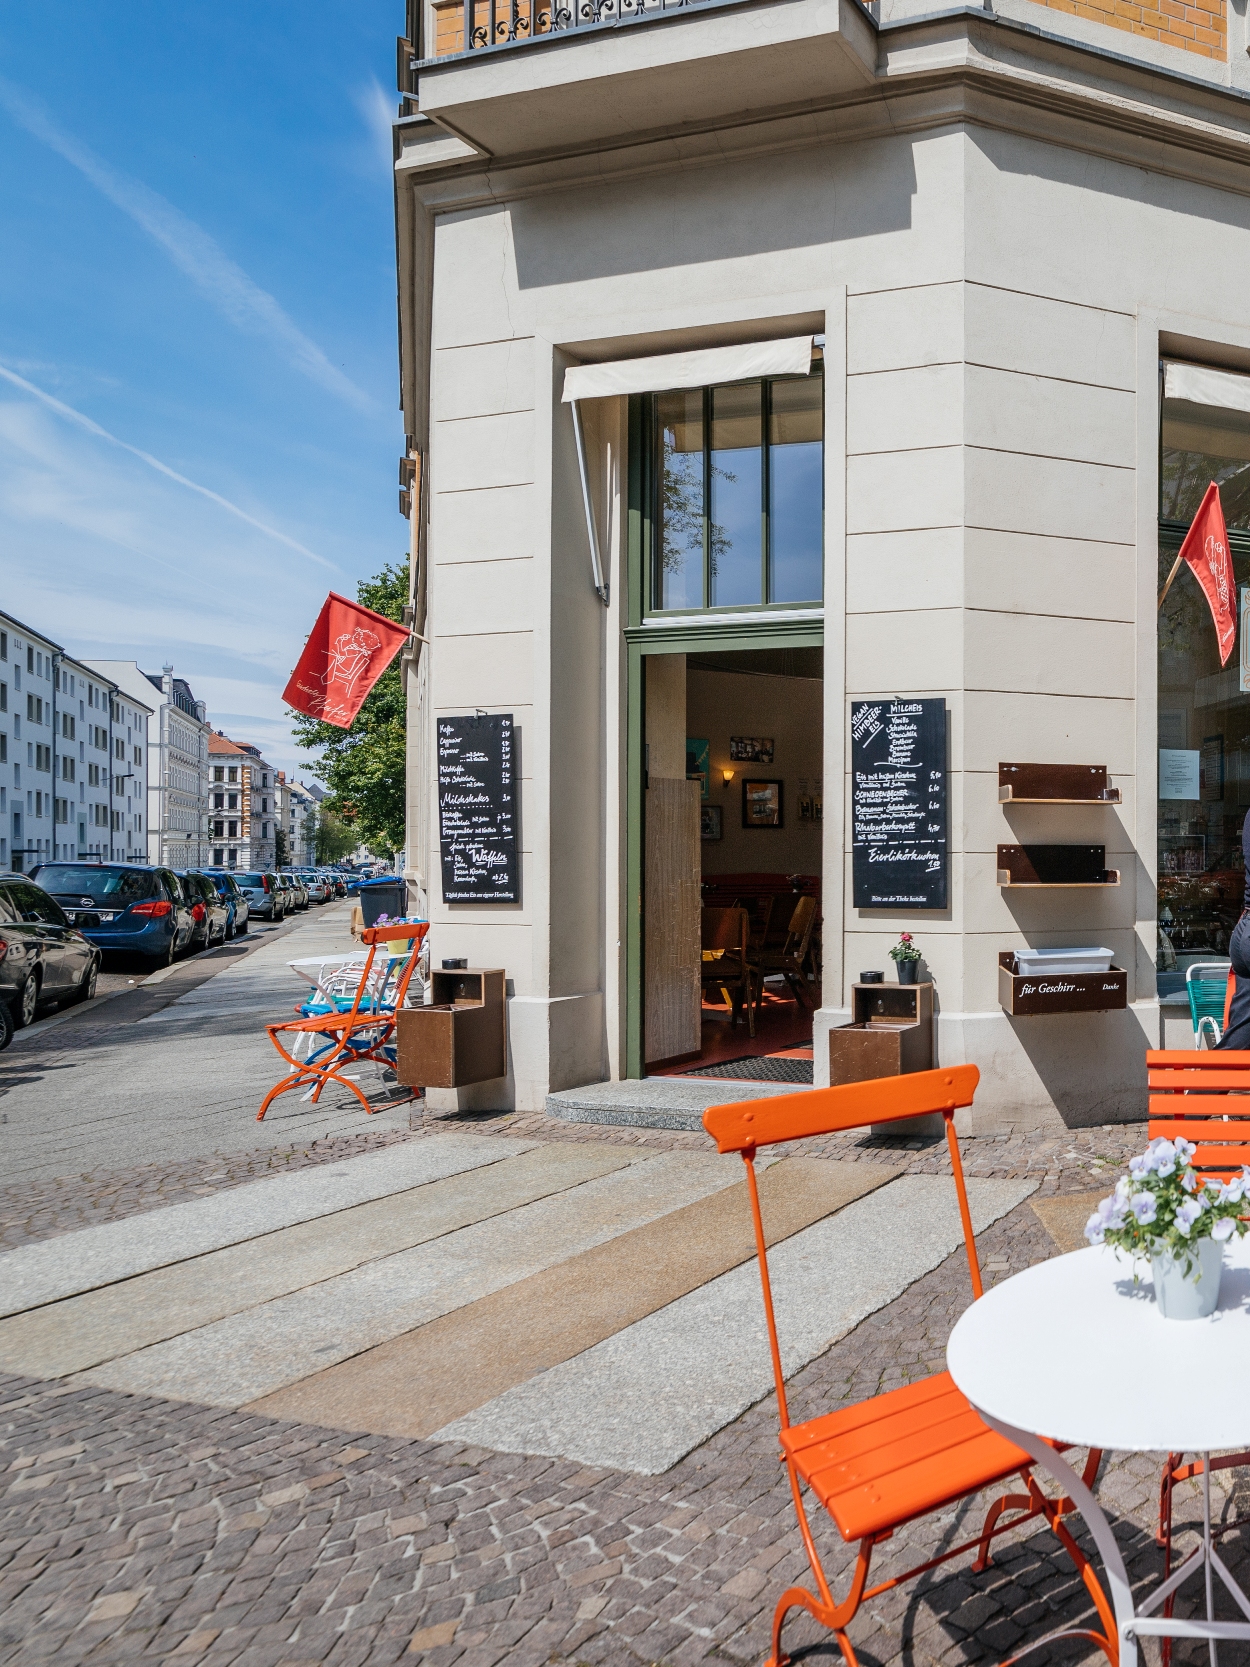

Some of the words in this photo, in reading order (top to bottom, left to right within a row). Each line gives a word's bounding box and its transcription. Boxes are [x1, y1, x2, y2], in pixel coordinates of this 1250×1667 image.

[851, 703, 869, 725] VEGAN
[890, 704, 922, 714] MILCHEIS
[869, 721, 881, 733] EIS
[856, 771, 867, 780] Eis
[440, 792, 490, 807] Milchshakes
[469, 849, 508, 868] Waffeln
[868, 847, 939, 863] Eierlikörkuchen
[1019, 984, 1036, 997] für
[1038, 982, 1075, 993] Geschirr
